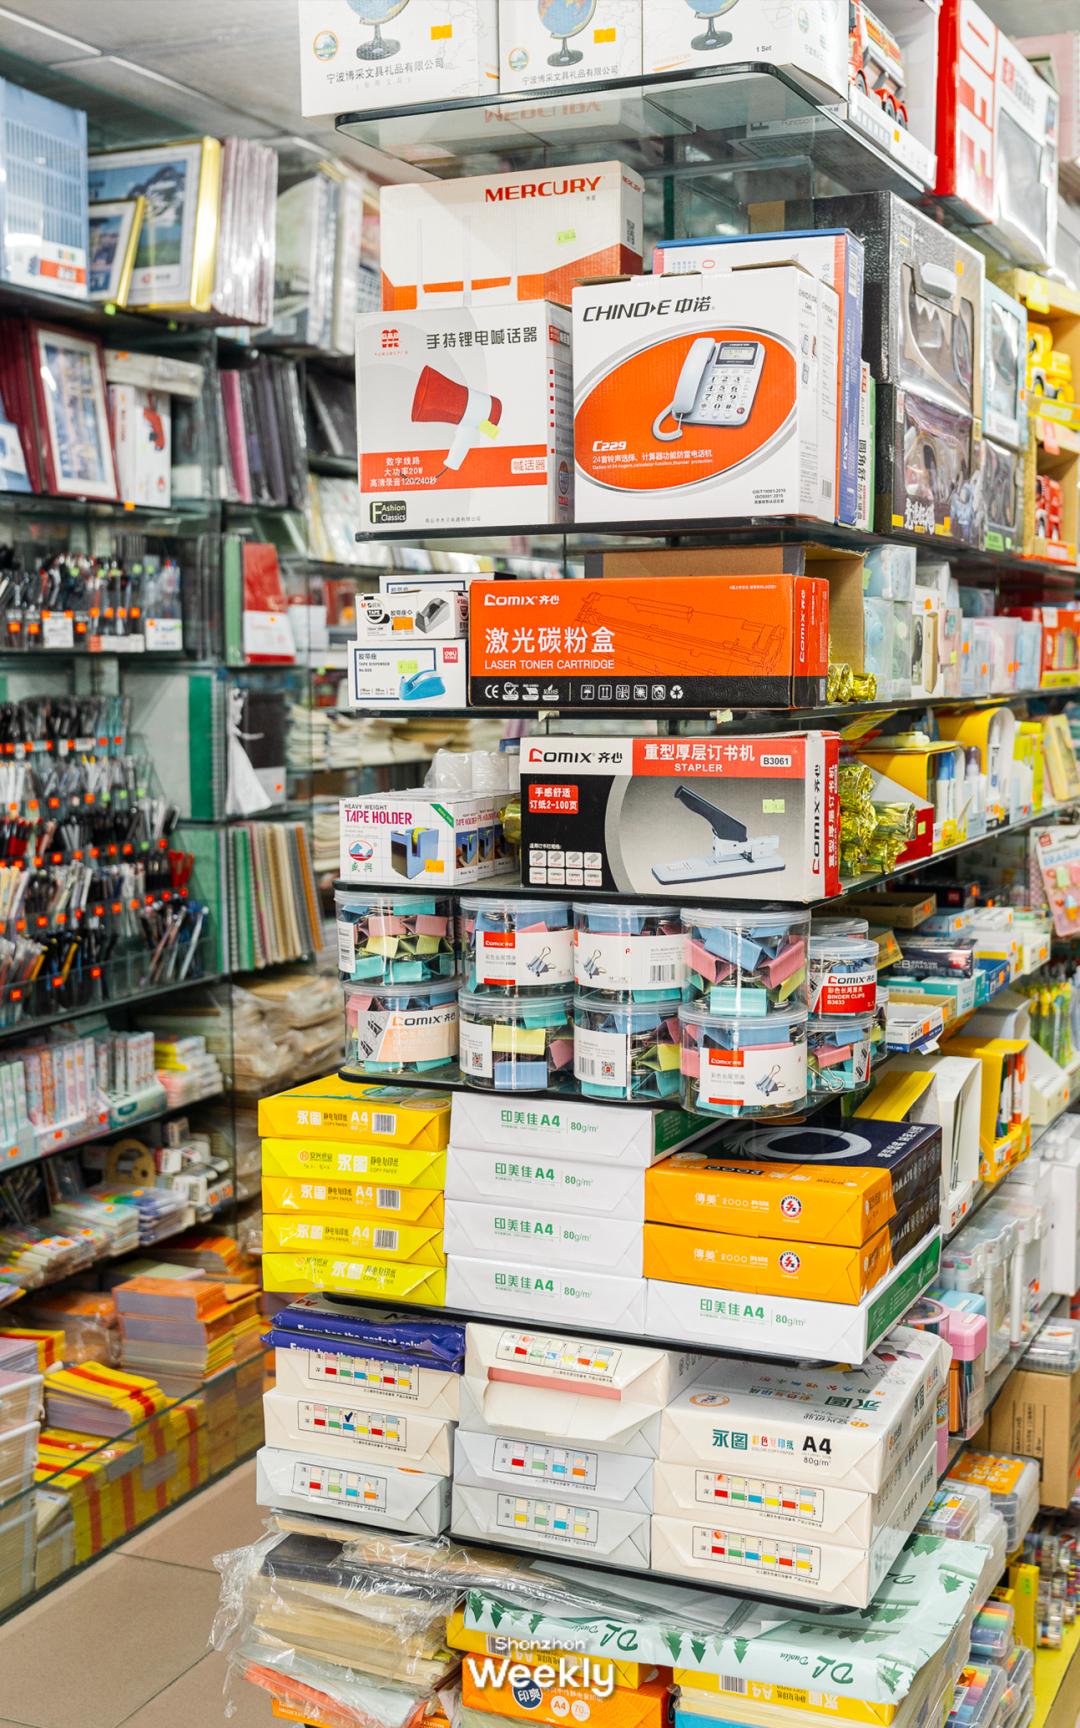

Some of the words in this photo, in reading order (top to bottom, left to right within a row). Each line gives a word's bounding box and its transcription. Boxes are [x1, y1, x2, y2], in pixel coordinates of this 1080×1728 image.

[326, 57, 445, 84] 宁波博采文具礼品有限公司
[485, 175, 602, 203] MERCURY
[674, 295, 712, 316] 中诺
[426, 326, 538, 350] 手持锂电喊话器
[592, 440, 627, 452] C229
[385, 457, 420, 467] 数字线路
[513, 459, 545, 472] 喊话器
[538, 594, 560, 606] 齐心
[485, 626, 616, 655] 激光碳粉盒
[485, 660, 518, 670] LASER
[520, 660, 554, 670] TONER
[557, 659, 615, 670] CARTRIDGE
[597, 750, 623, 764] 齐心
[644, 743, 755, 762] 重型厚层订书机
[674, 763, 723, 773] STAPLER
[763, 757, 789, 766] B3061
[534, 787, 571, 799] 手感舒适
[529, 799, 578, 810] 订纸2-100页
[344, 809, 370, 824] TAPE
[371, 811, 413, 825] HOLDER
[351, 1111, 369, 1123] A4
[501, 1109, 538, 1126] 印美佳
[540, 1113, 560, 1127] A4
[337, 1153, 368, 1173] 永图
[494, 1162, 532, 1179] 印美佳
[535, 1167, 555, 1181] A4
[355, 1185, 373, 1198] A4
[352, 1225, 370, 1239] A4
[494, 1217, 532, 1234] 印美佳
[534, 1222, 554, 1236] A4
[495, 1273, 532, 1290] 印美佳
[534, 1278, 554, 1292] A4
[700, 1298, 741, 1316] 印美佳
[743, 1305, 765, 1319] A4
[712, 1428, 748, 1450] 永图
[802, 1435, 832, 1455] A4
[812, 1655, 854, 1684] DL
[553, 1702, 566, 1711] A4
